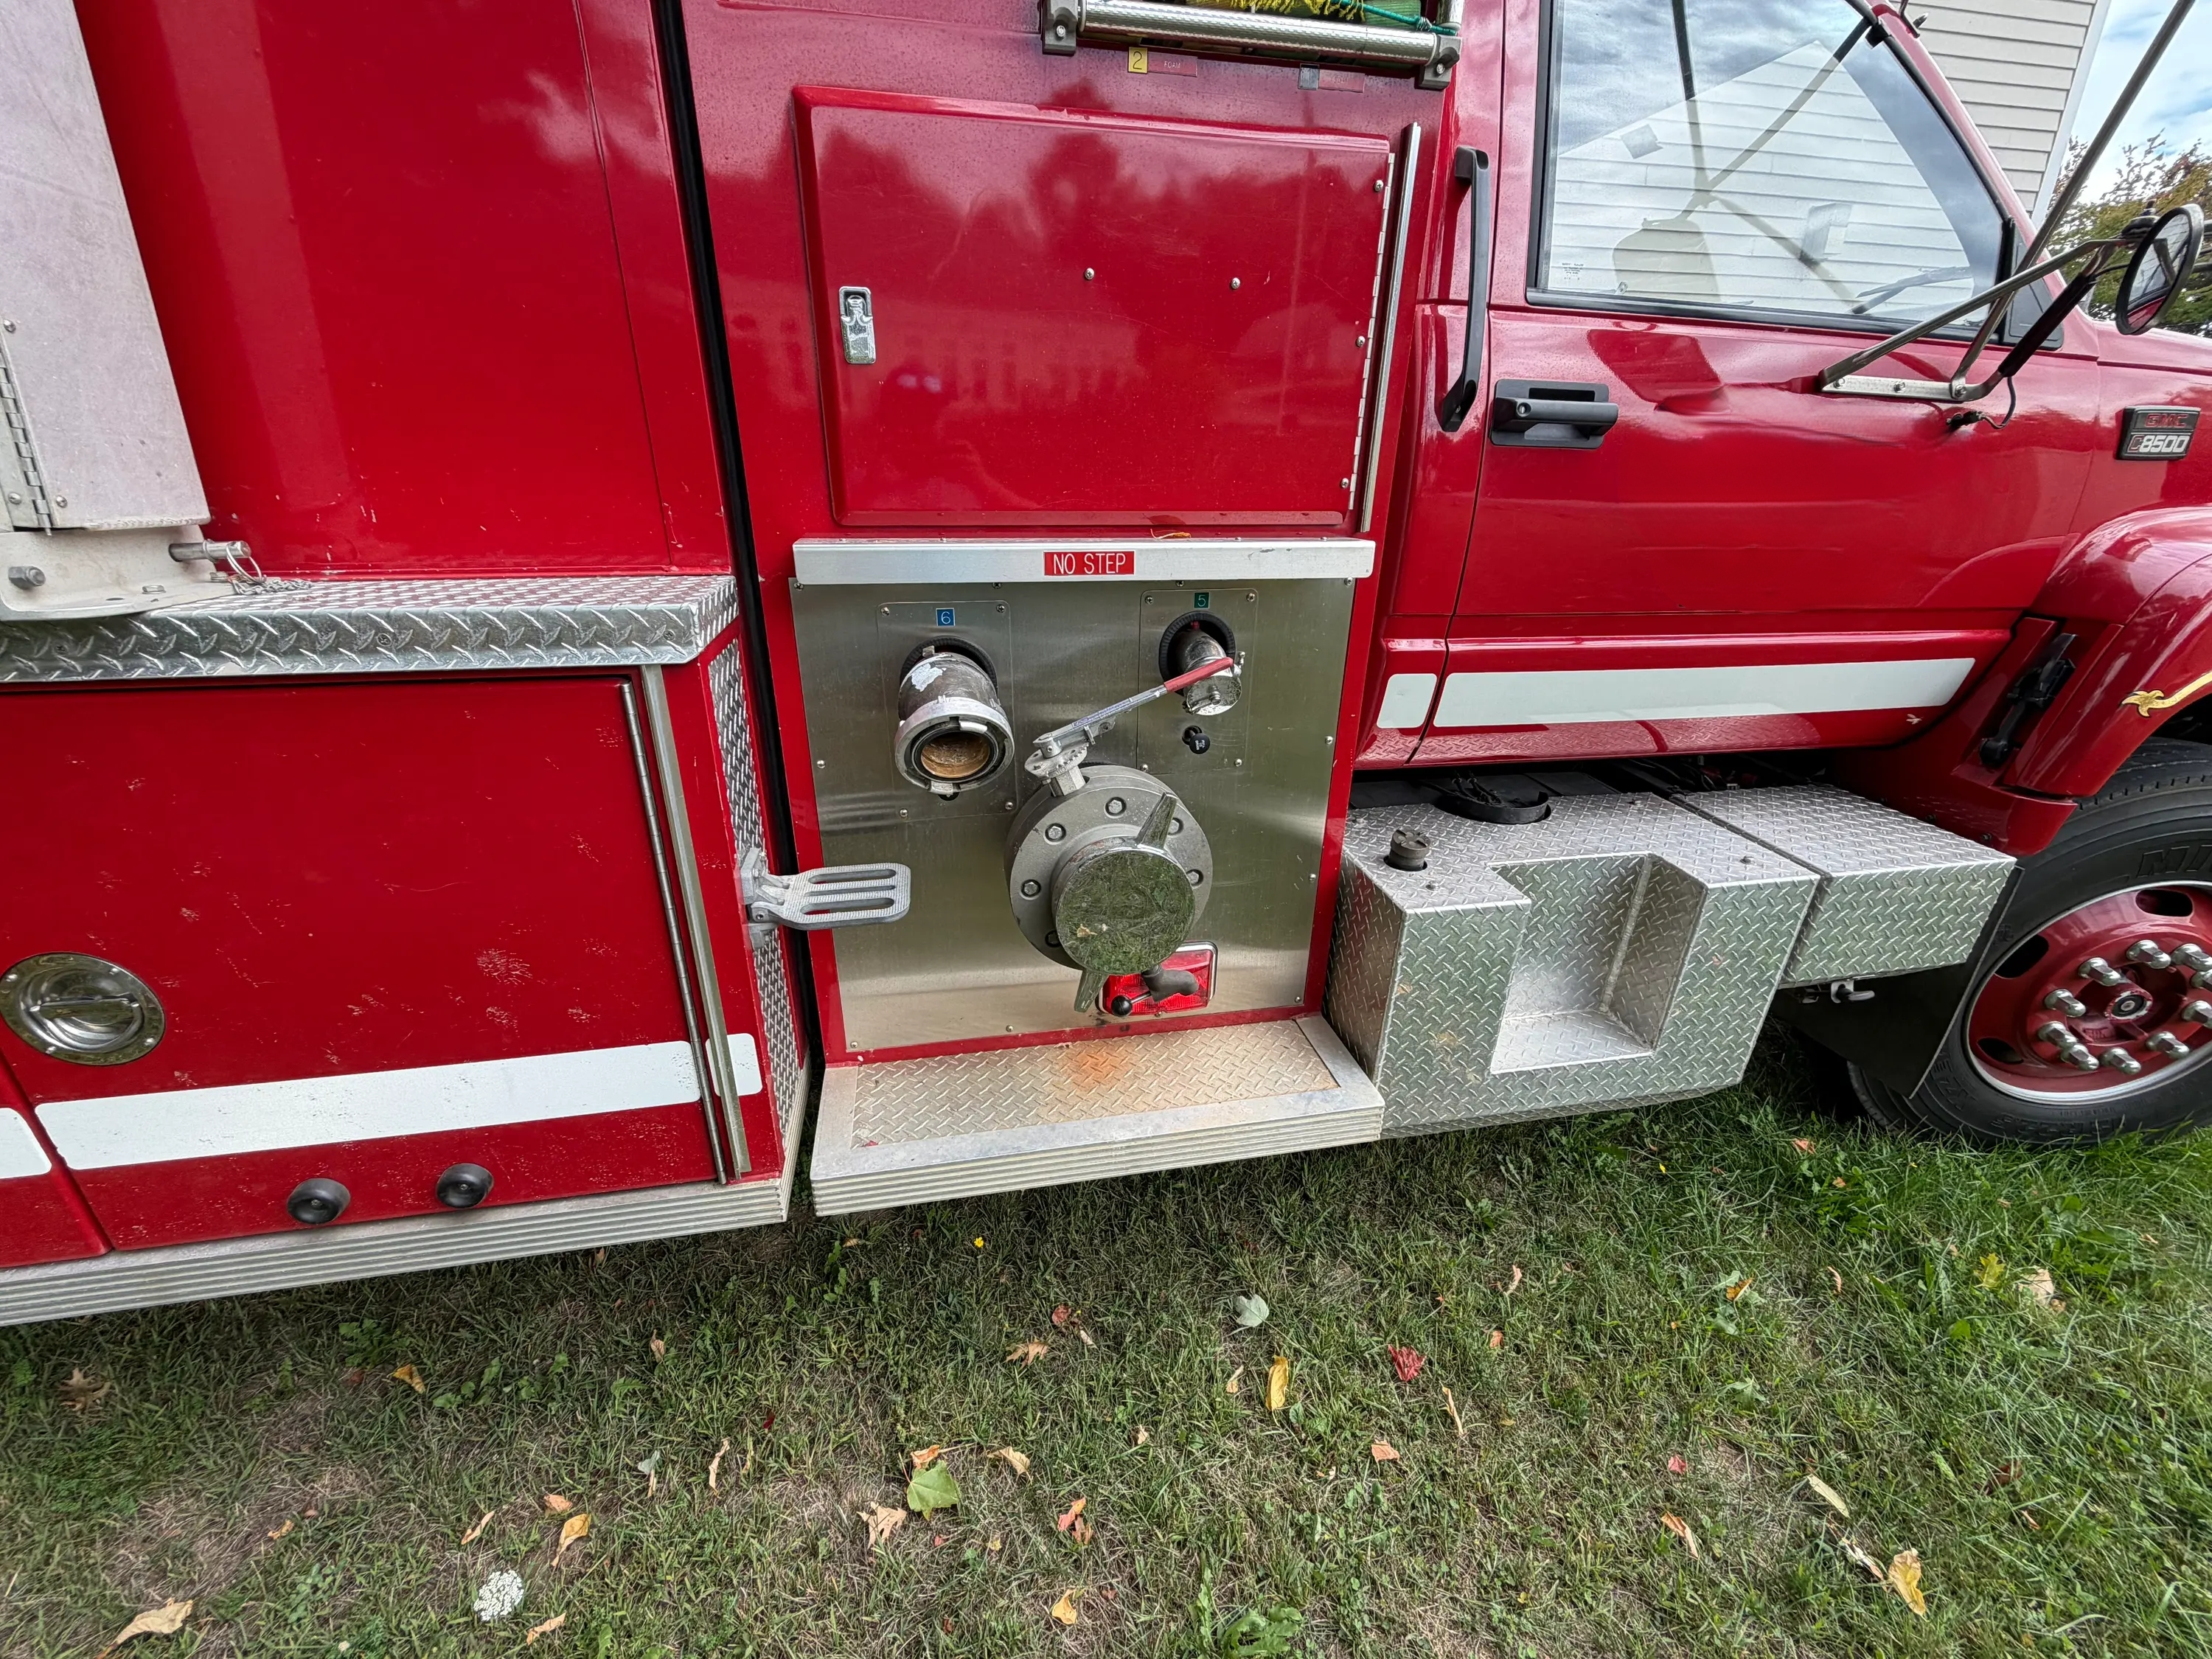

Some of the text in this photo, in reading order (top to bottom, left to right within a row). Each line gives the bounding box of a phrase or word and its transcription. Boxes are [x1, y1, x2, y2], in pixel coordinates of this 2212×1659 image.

[1133, 51, 1181, 70] 2 FOAM
[2144, 413, 2189, 428] GMC
[2126, 434, 2191, 453] C8500
[1053, 553, 1126, 574] NO STEP
[1197, 594, 1206, 607] 5
[941, 611, 951, 625] 6
